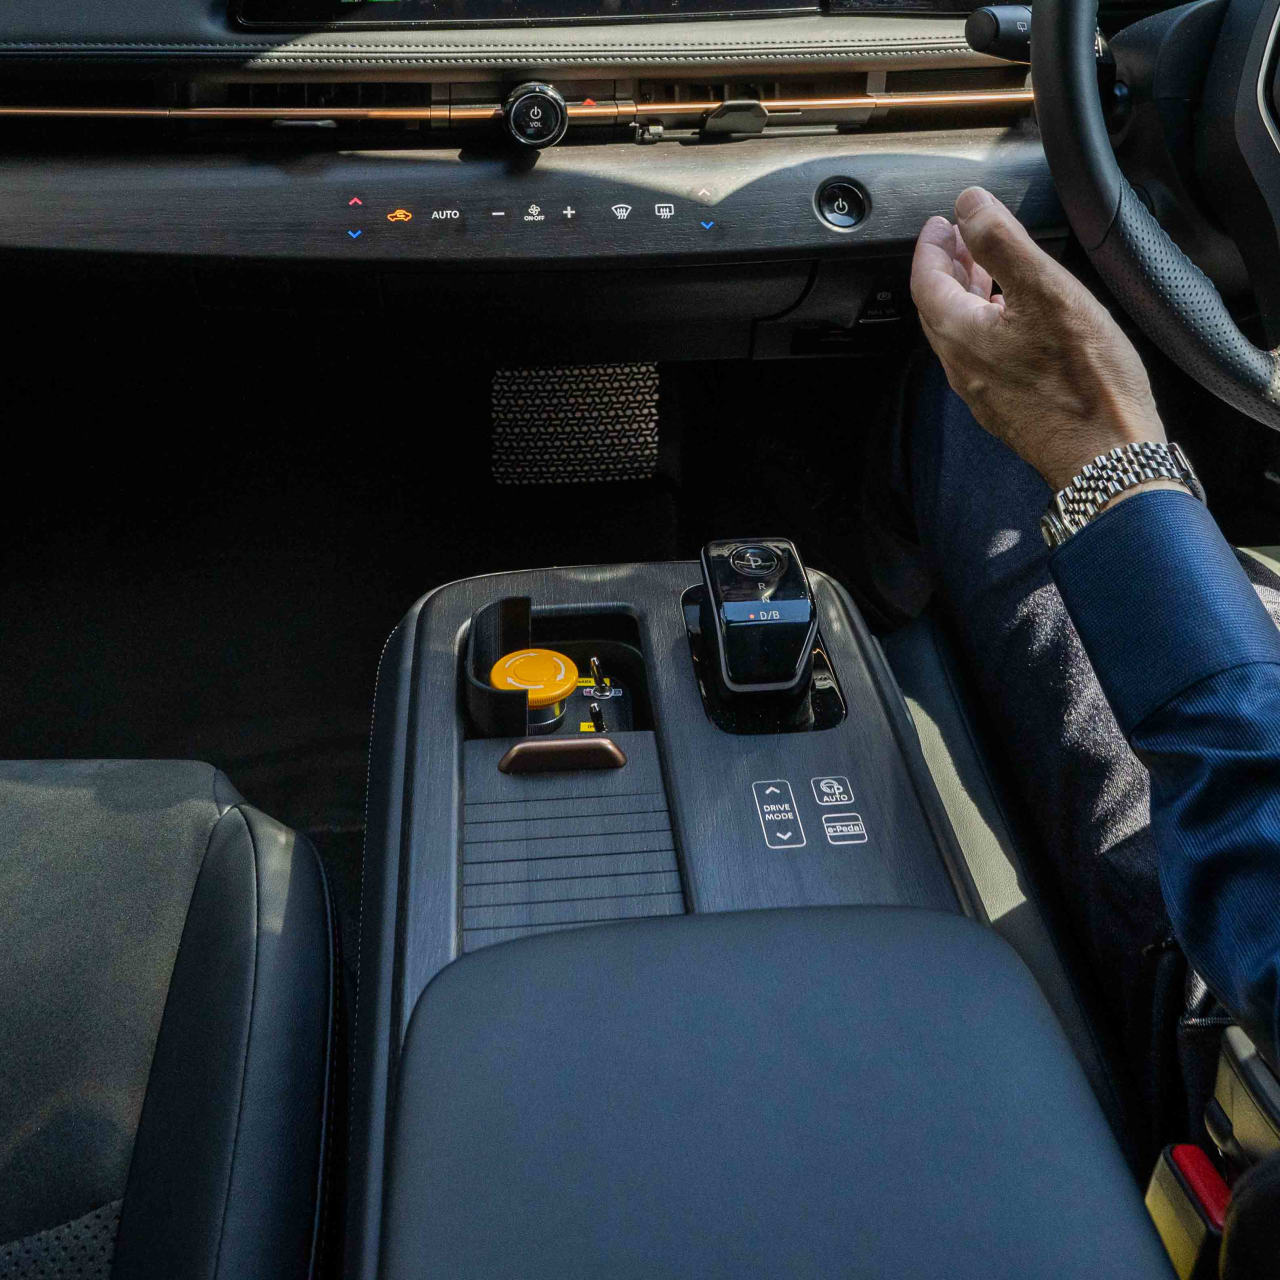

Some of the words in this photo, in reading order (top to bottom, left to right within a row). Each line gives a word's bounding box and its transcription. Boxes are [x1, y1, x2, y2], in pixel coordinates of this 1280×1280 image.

[431, 210, 460, 219] AUTO
[750, 557, 762, 569] P
[757, 582, 766, 590] R
[761, 595, 770, 604] N
[759, 611, 780, 620] D/B
[823, 794, 848, 802] AUTO
[763, 803, 791, 812] DRIVE
[765, 812, 794, 821] MODE
[827, 823, 863, 833] e-Pedal
